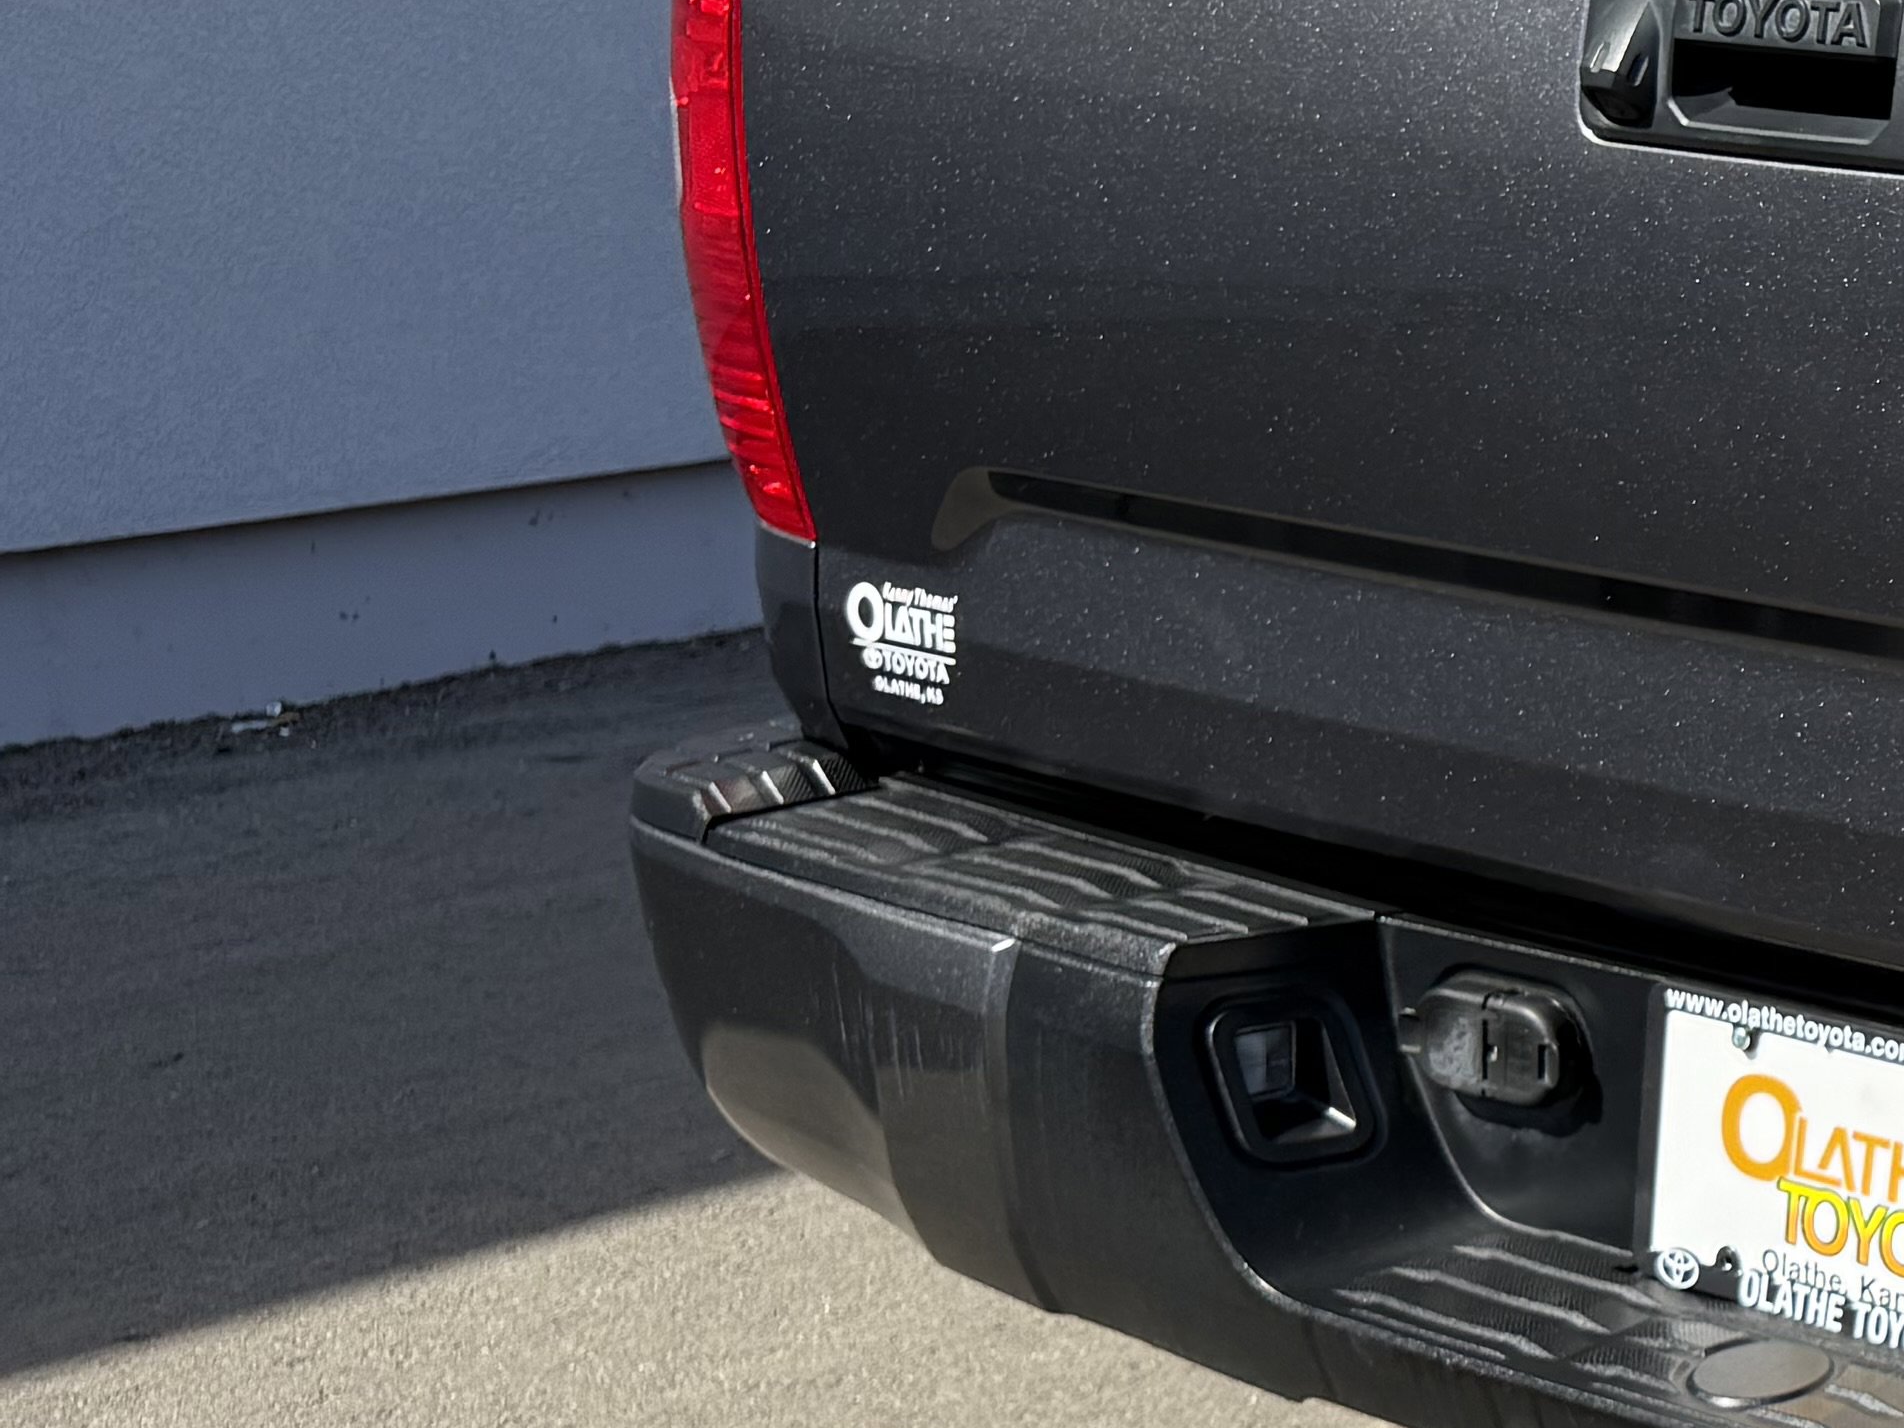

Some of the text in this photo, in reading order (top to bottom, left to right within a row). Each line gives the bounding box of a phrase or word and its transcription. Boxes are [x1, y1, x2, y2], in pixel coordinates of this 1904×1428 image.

[846, 581, 957, 654] OLATHE
[882, 647, 951, 685] TOYOTA
[1738, 1269, 1846, 1334] OLATHE
